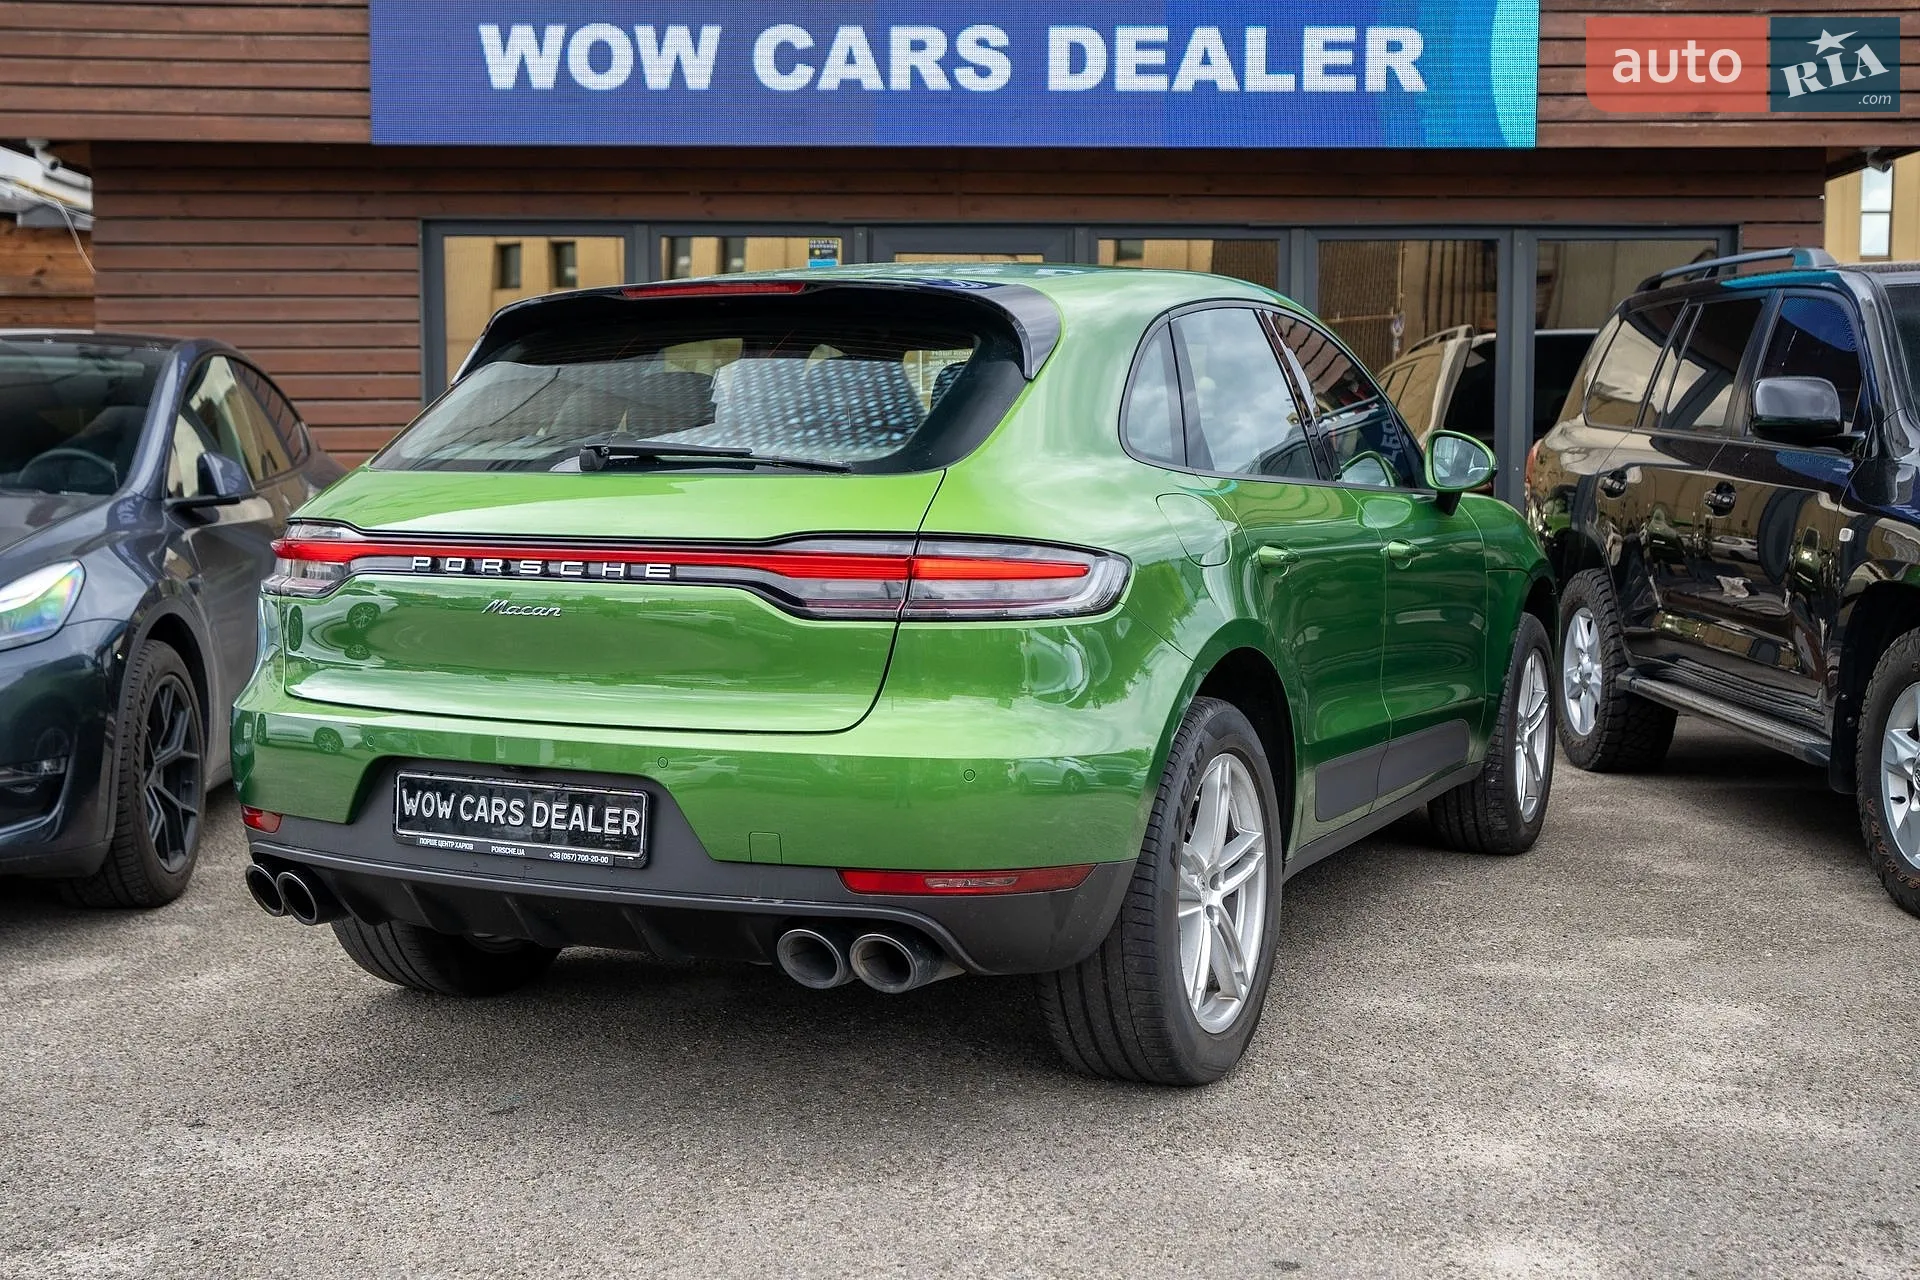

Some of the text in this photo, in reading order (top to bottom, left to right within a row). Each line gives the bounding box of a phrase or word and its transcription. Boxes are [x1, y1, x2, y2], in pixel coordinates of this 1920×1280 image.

[479, 23, 1428, 93] WOW CARS DEALER
[411, 556, 672, 578] PORSCHE
[481, 599, 561, 617] Macan
[1174, 740, 1205, 837] ZERO
[402, 788, 641, 837] WOW CARS DEALER
[491, 845, 526, 856] PORSCHE.UA
[549, 852, 561, 860] +38
[577, 854, 609, 864] 700-20-00
